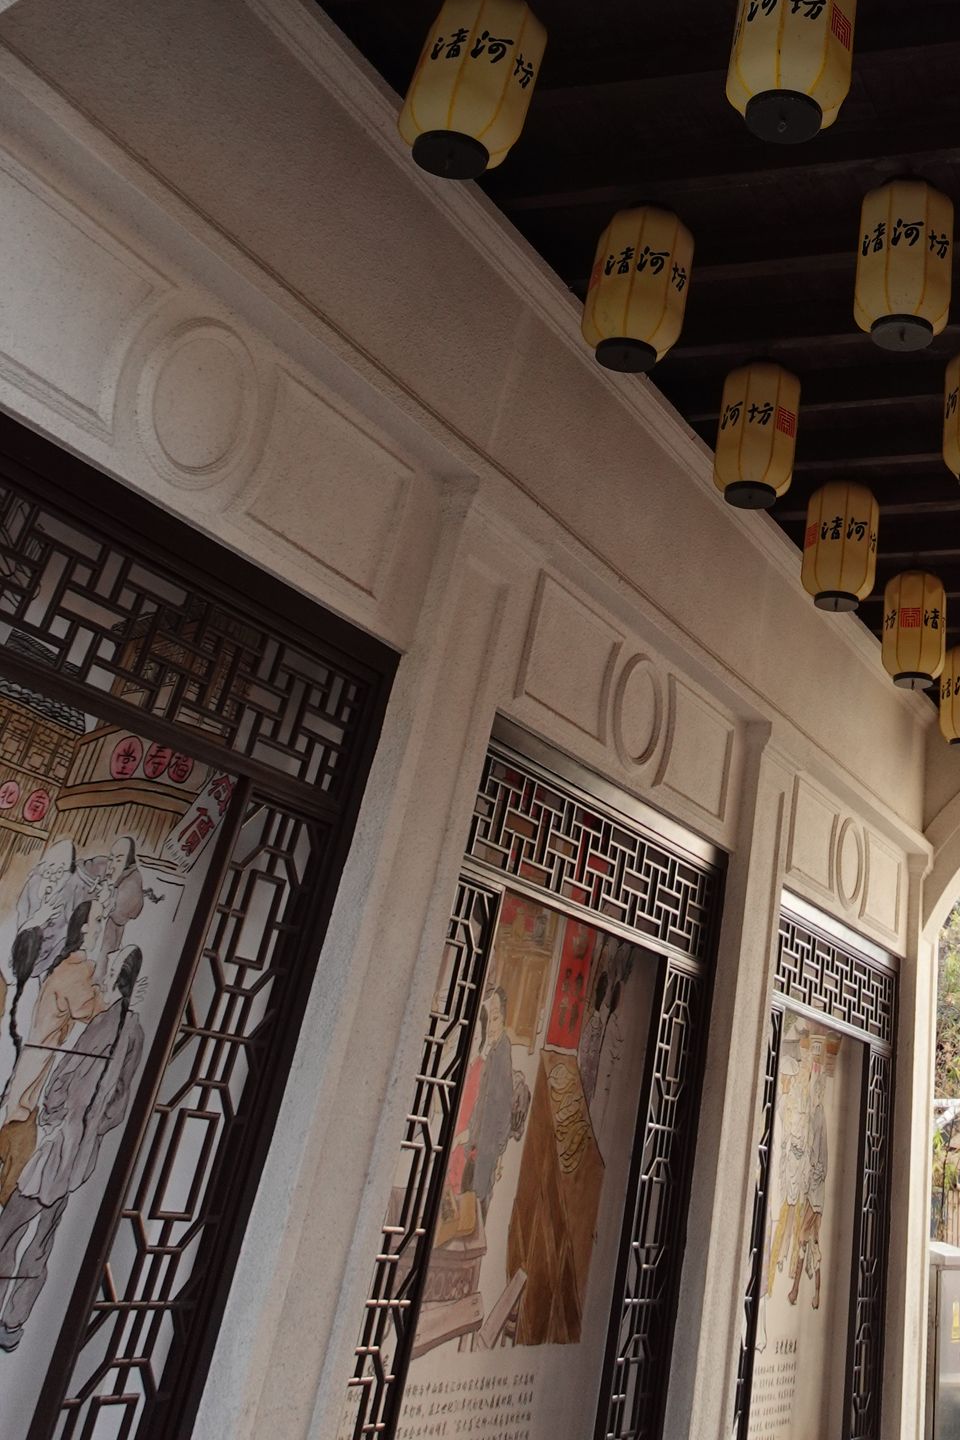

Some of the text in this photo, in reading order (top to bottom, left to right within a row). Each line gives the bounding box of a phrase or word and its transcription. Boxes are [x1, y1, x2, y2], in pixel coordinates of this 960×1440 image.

[430, 28, 535, 89] 清河坊
[862, 218, 950, 259] 清河坊
[604, 246, 687, 292] 清河坊
